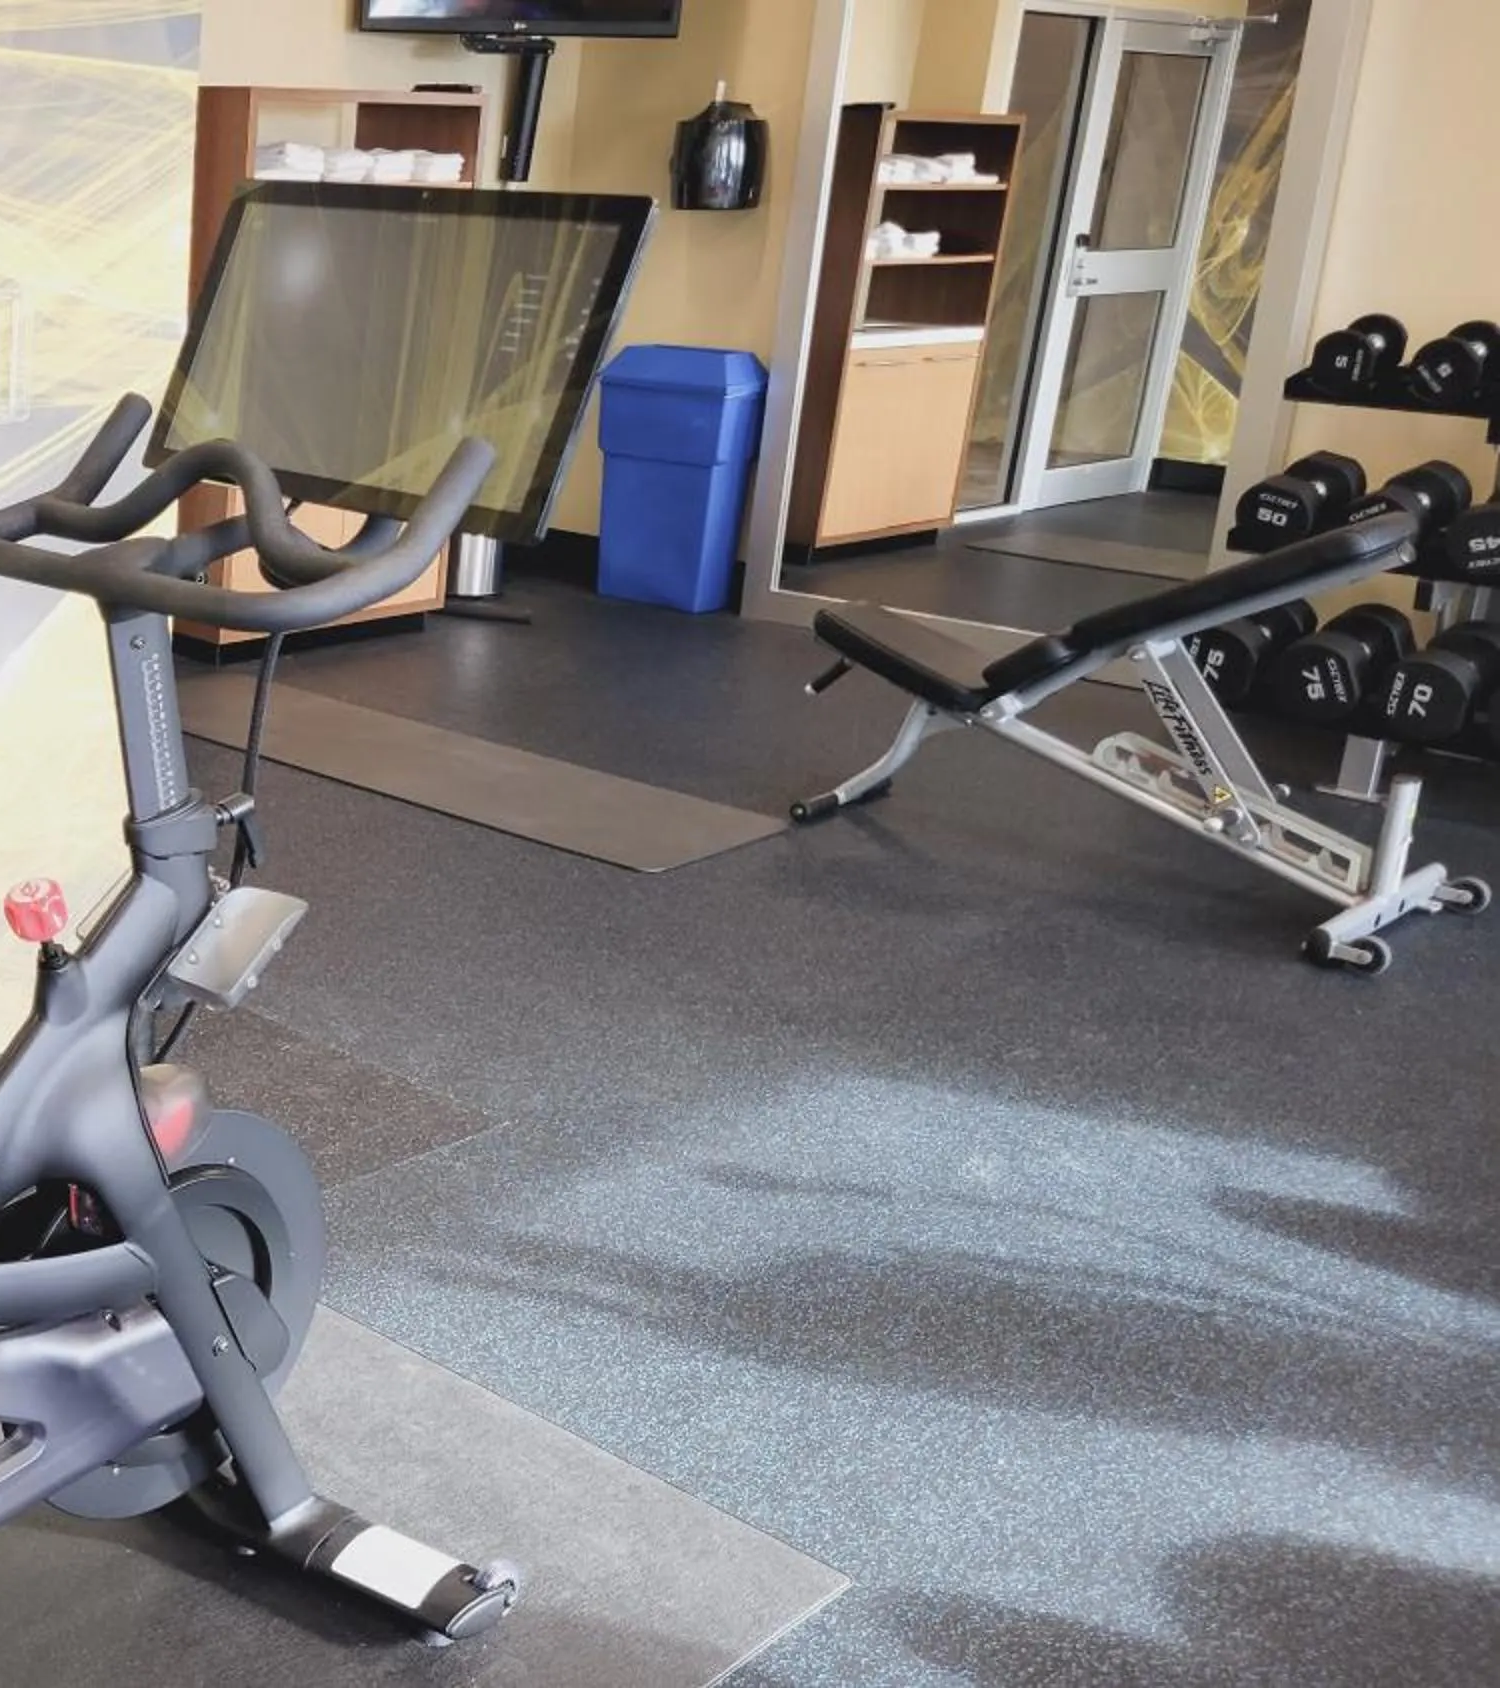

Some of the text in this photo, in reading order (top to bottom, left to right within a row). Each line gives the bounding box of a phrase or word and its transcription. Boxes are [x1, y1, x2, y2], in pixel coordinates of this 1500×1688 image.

[1257, 507, 1288, 526] 50
[1203, 648, 1225, 681] 75
[1302, 665, 1326, 701] 75
[1407, 683, 1433, 717] 70
